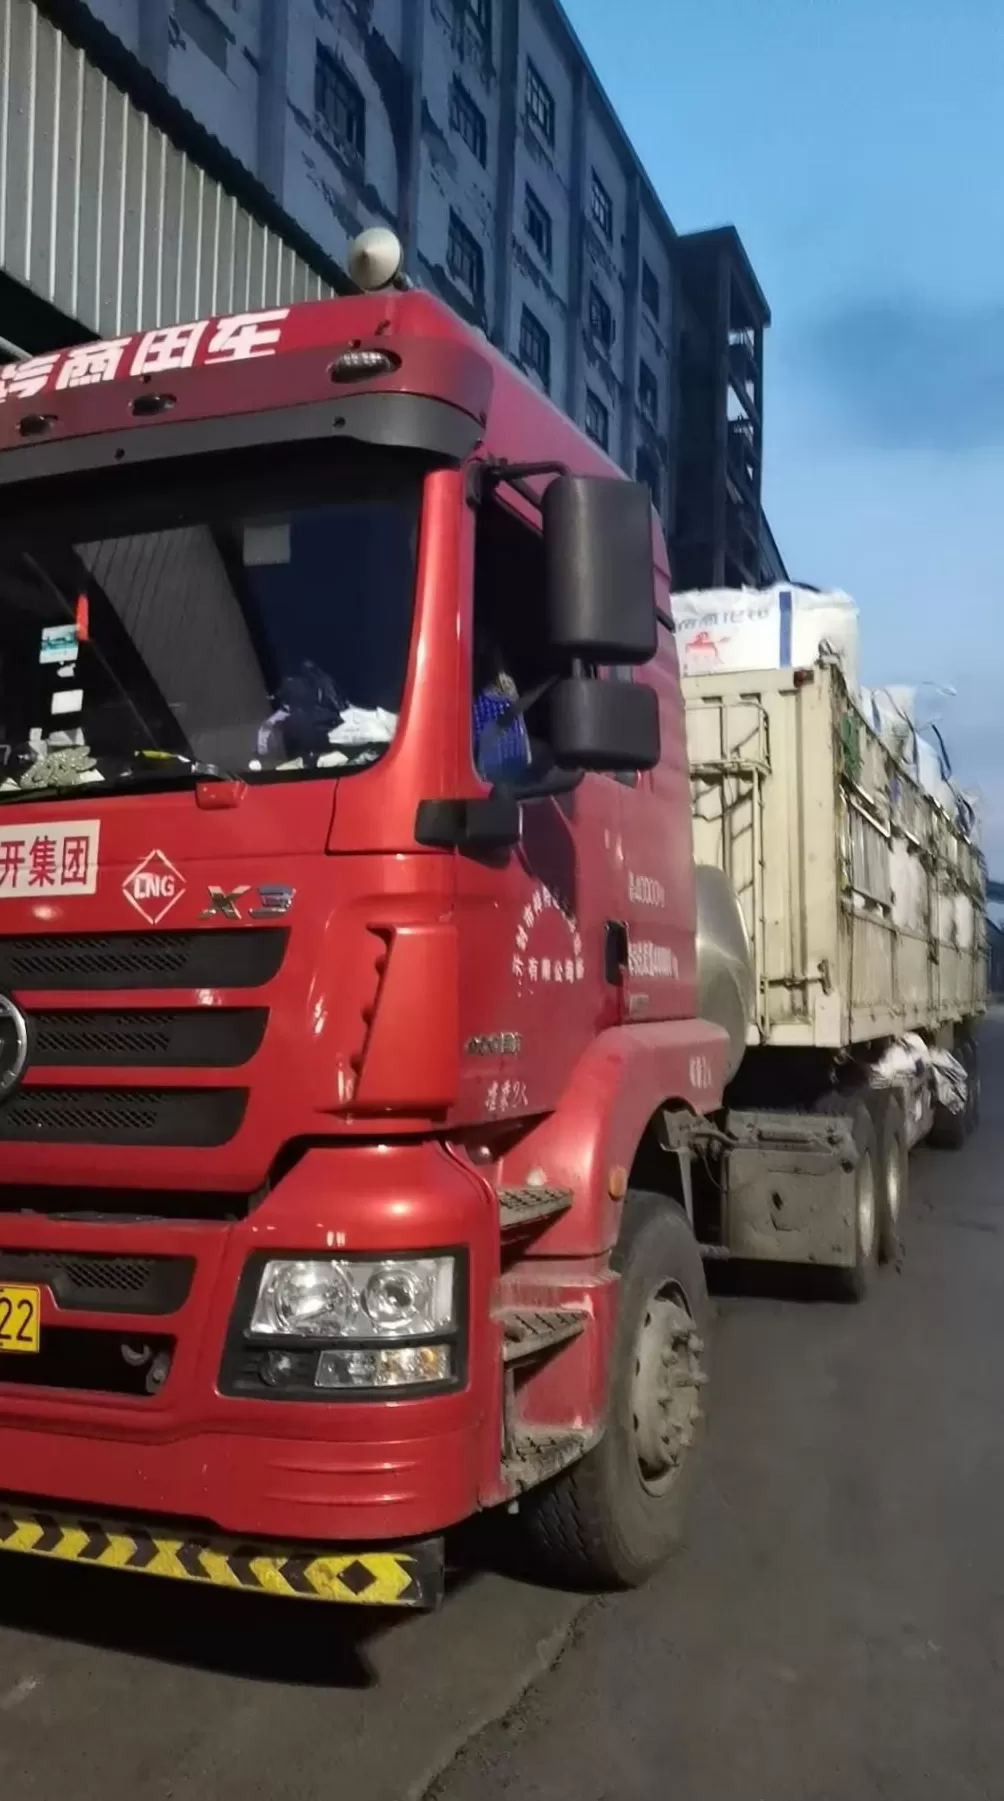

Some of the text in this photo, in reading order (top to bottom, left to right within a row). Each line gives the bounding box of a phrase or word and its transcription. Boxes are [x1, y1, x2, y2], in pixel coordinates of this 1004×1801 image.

[0, 835, 90, 888] 开集团
[0, 1297, 33, 1343] 22
